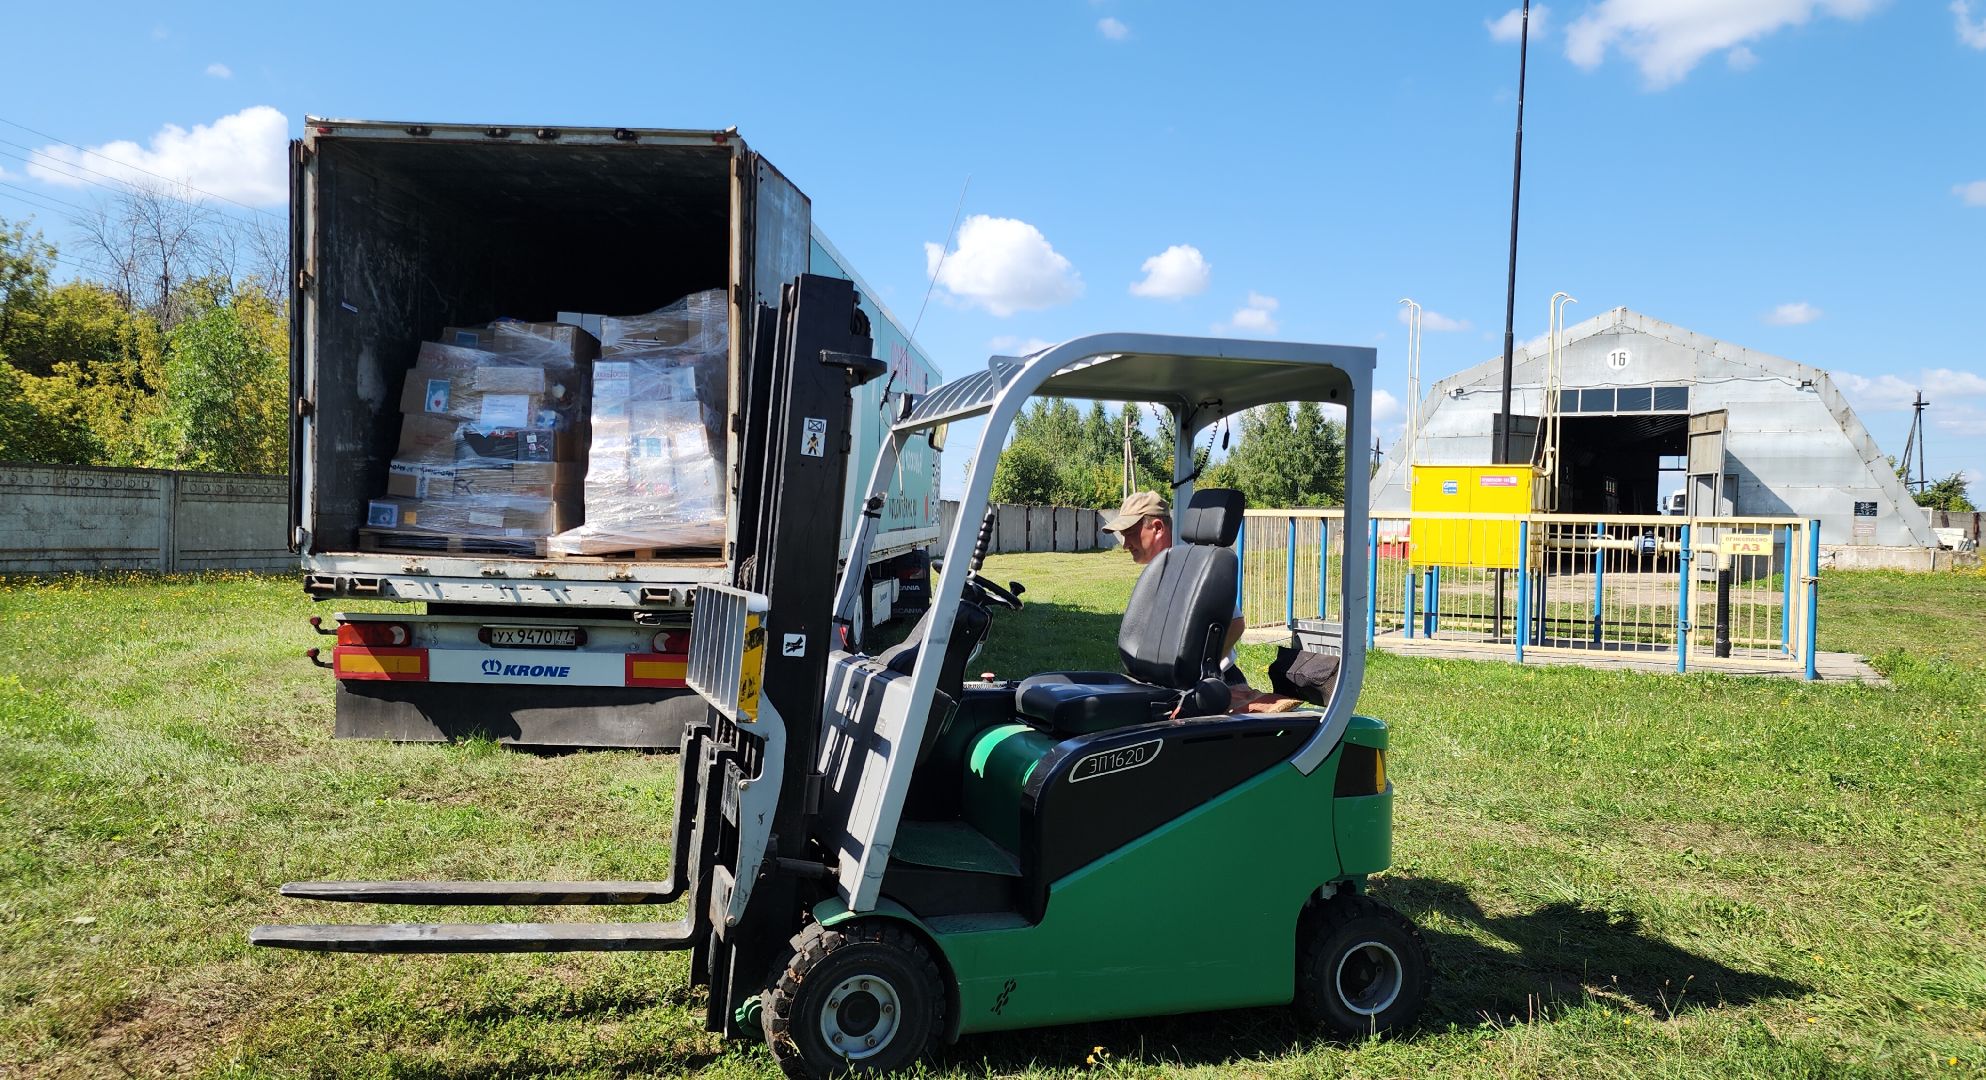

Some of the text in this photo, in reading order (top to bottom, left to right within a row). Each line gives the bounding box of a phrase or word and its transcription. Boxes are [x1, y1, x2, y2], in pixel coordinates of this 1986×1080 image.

[1611, 352, 1626, 366] 16
[1732, 543, 1760, 551] ГАЗ
[517, 629, 553, 644] 9470
[503, 665, 570, 677] KRONE
[1088, 747, 1145, 774] ЭП1620
